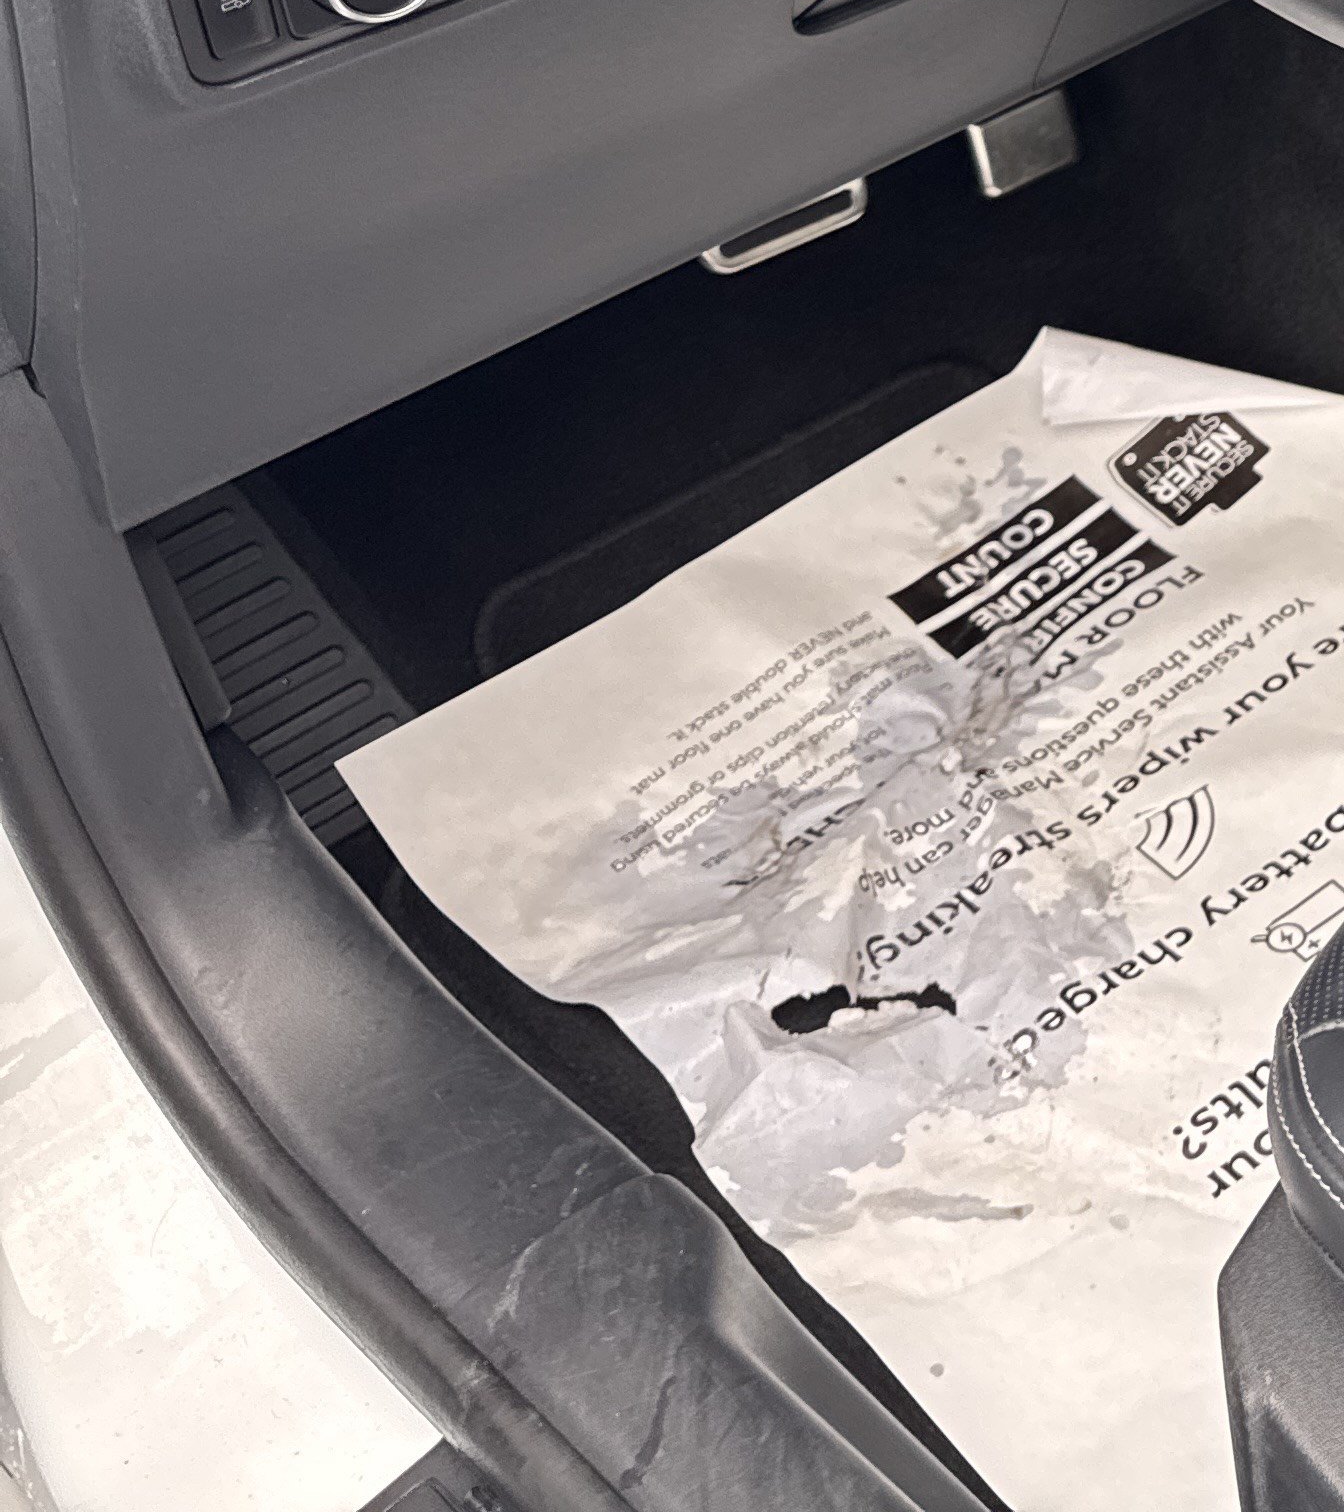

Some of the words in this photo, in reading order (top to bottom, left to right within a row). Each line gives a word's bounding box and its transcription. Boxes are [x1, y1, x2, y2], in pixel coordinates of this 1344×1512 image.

[1146, 421, 1241, 505] NEVER
[1150, 415, 1221, 469] STACK
[1134, 461, 1161, 488] IT
[1183, 438, 1255, 502] SECURE
[1169, 493, 1191, 516] IT
[933, 505, 1058, 600] COUNT
[967, 536, 1100, 634] SECURE
[1079, 567, 1203, 645] FLOOR
[1189, 614, 1242, 649] with
[1260, 598, 1314, 636] Your
[814, 645, 847, 667] sure
[1122, 650, 1189, 696] these
[1151, 633, 1255, 710] Assistant
[731, 659, 787, 703] double
[783, 665, 812, 693] you
[1224, 653, 1313, 724] your
[686, 701, 729, 731] stack
[744, 693, 785, 721] have
[765, 695, 836, 748] retention
[709, 720, 742, 742] one
[1003, 698, 1119, 772] questions
[1064, 709, 1152, 772] Service
[669, 742, 710, 769] floor
[727, 747, 764, 772] clips
[1077, 728, 1218, 826] wipers
[631, 767, 665, 795] mat
[708, 771, 725, 785] or
[955, 767, 999, 815] and
[659, 789, 733, 846] secured
[884, 809, 955, 845] more.
[960, 771, 1064, 841] Manager
[905, 841, 953, 874] can
[859, 867, 905, 895] help
